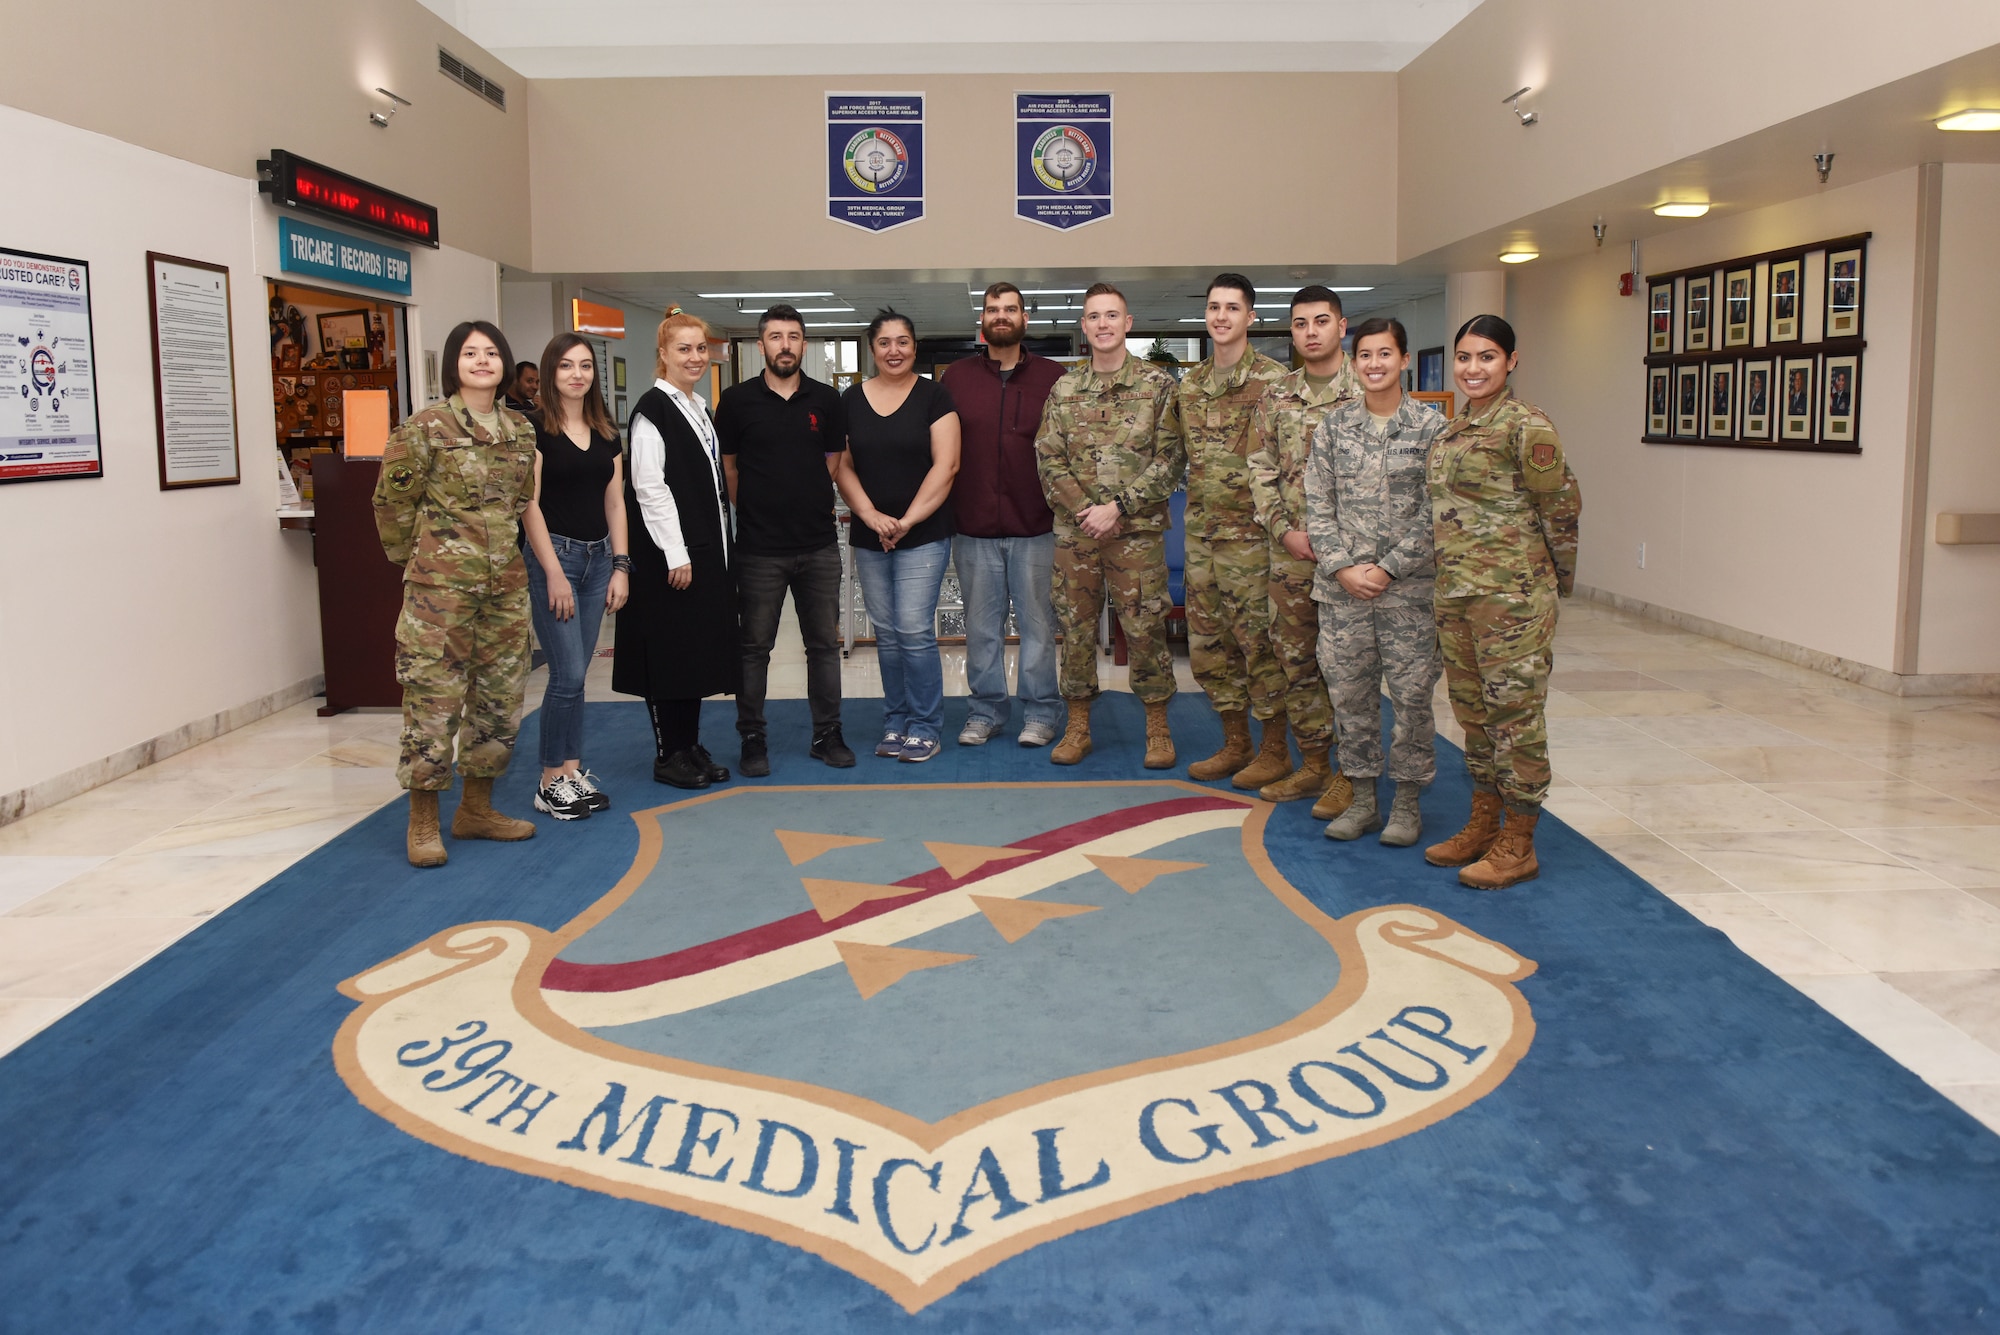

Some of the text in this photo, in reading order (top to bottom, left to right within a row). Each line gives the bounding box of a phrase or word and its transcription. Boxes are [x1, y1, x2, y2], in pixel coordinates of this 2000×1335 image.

[848, 132, 869, 153] READINESS
[879, 132, 896, 145] BETTER
[893, 141, 903, 155] CARE
[1037, 131, 1057, 151] READINESS
[1068, 130, 1084, 143] BETTER
[1081, 139, 1091, 153] CARE
[878, 178, 895, 189] BETTER
[893, 164, 904, 181] HEALTH
[1067, 162, 1091, 187] BETTER HEALTH
[3, 258, 66, 274] DO YOU DEMONSTRATE
[290, 233, 334, 267] TRICARE
[341, 245, 381, 277] RECORDS
[387, 257, 408, 282] EFMP
[0, 268, 66, 287] USTED CARE?
[1387, 447, 1428, 457] U.S. AIR FORCE
[396, 1005, 1487, 1255] 39TH MEDICAL GROUP
